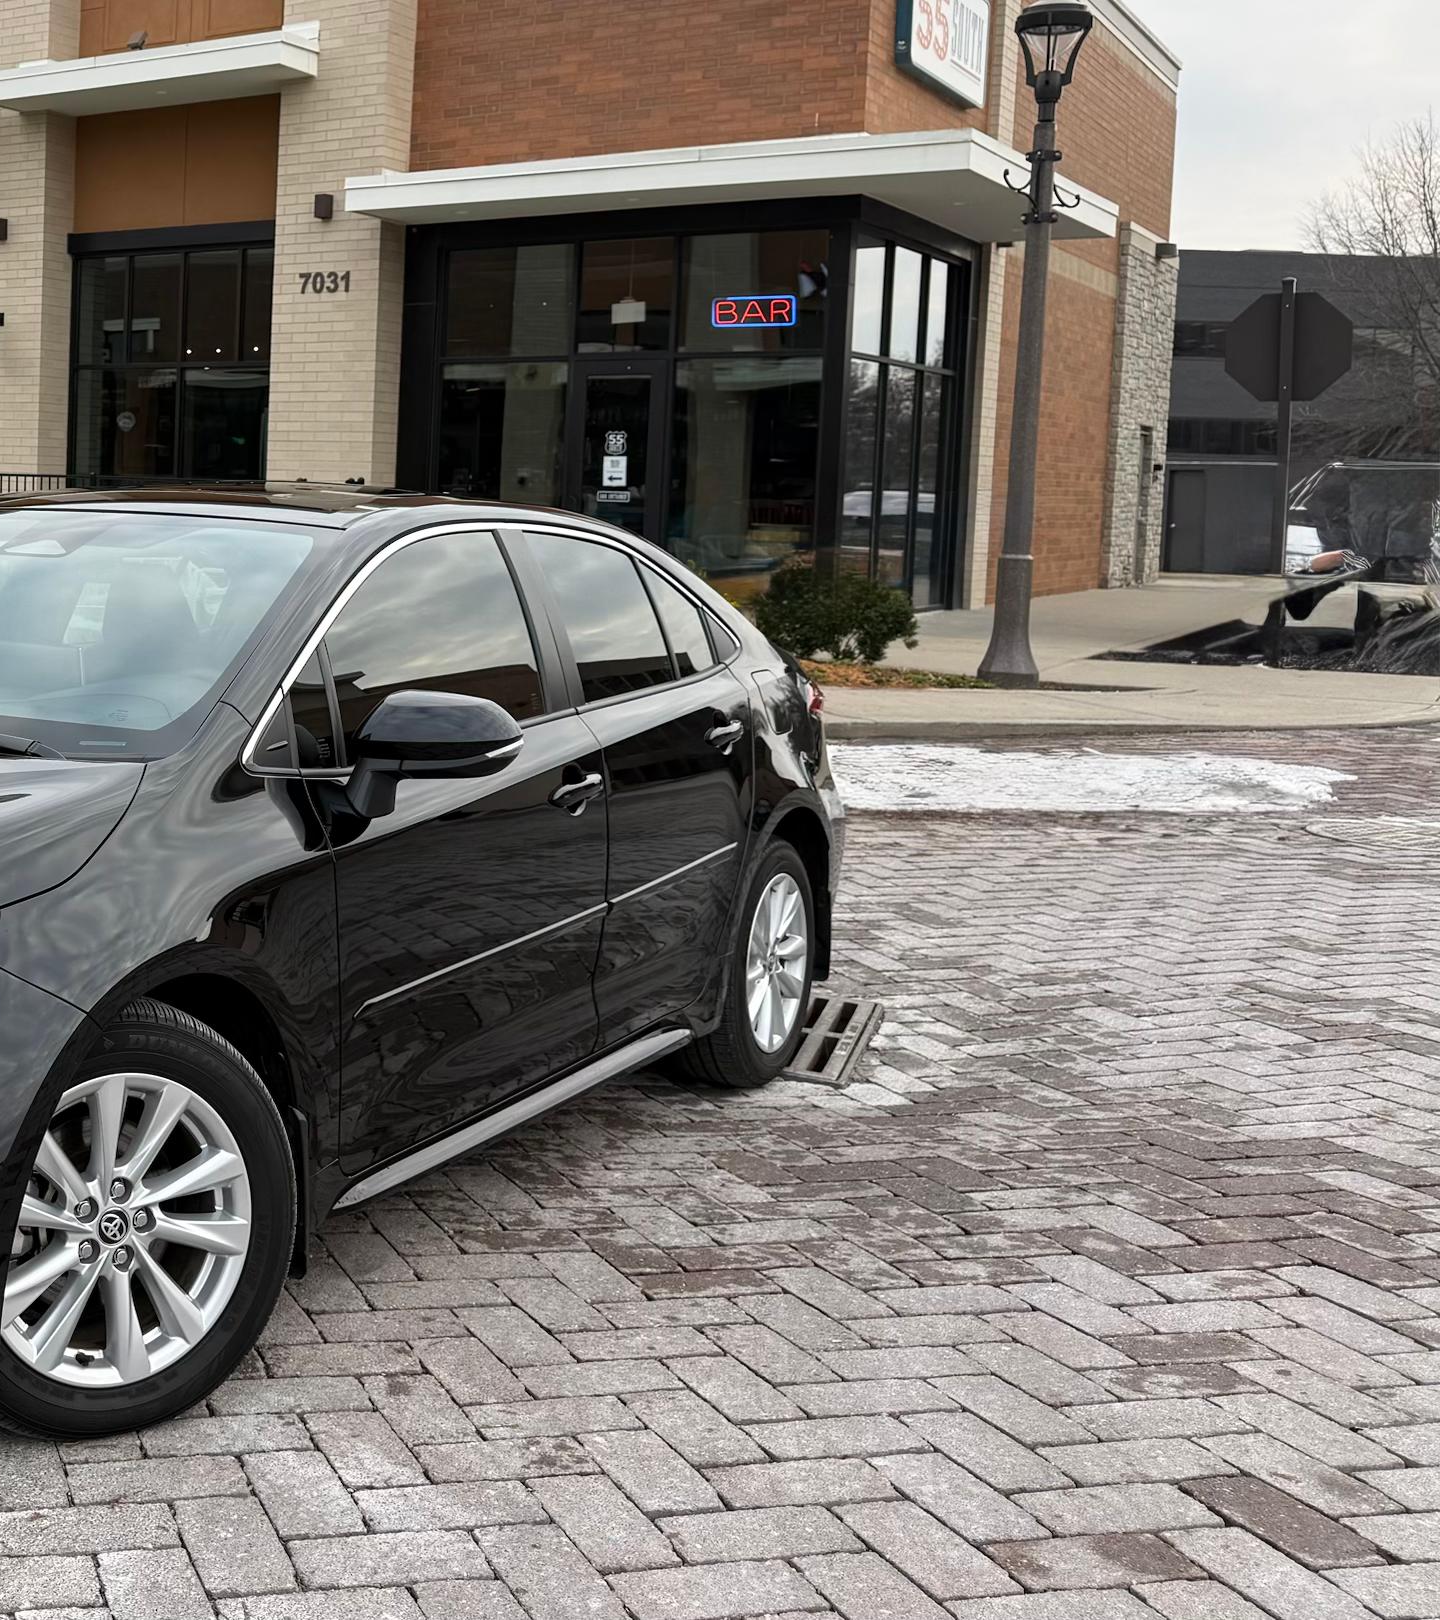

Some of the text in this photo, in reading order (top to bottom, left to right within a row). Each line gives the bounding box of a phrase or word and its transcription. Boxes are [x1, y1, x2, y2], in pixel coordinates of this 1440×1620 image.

[951, 0, 984, 75] SOUTH
[298, 270, 351, 295] 7031
[715, 299, 791, 324] BAR
[608, 434, 624, 447] 55
